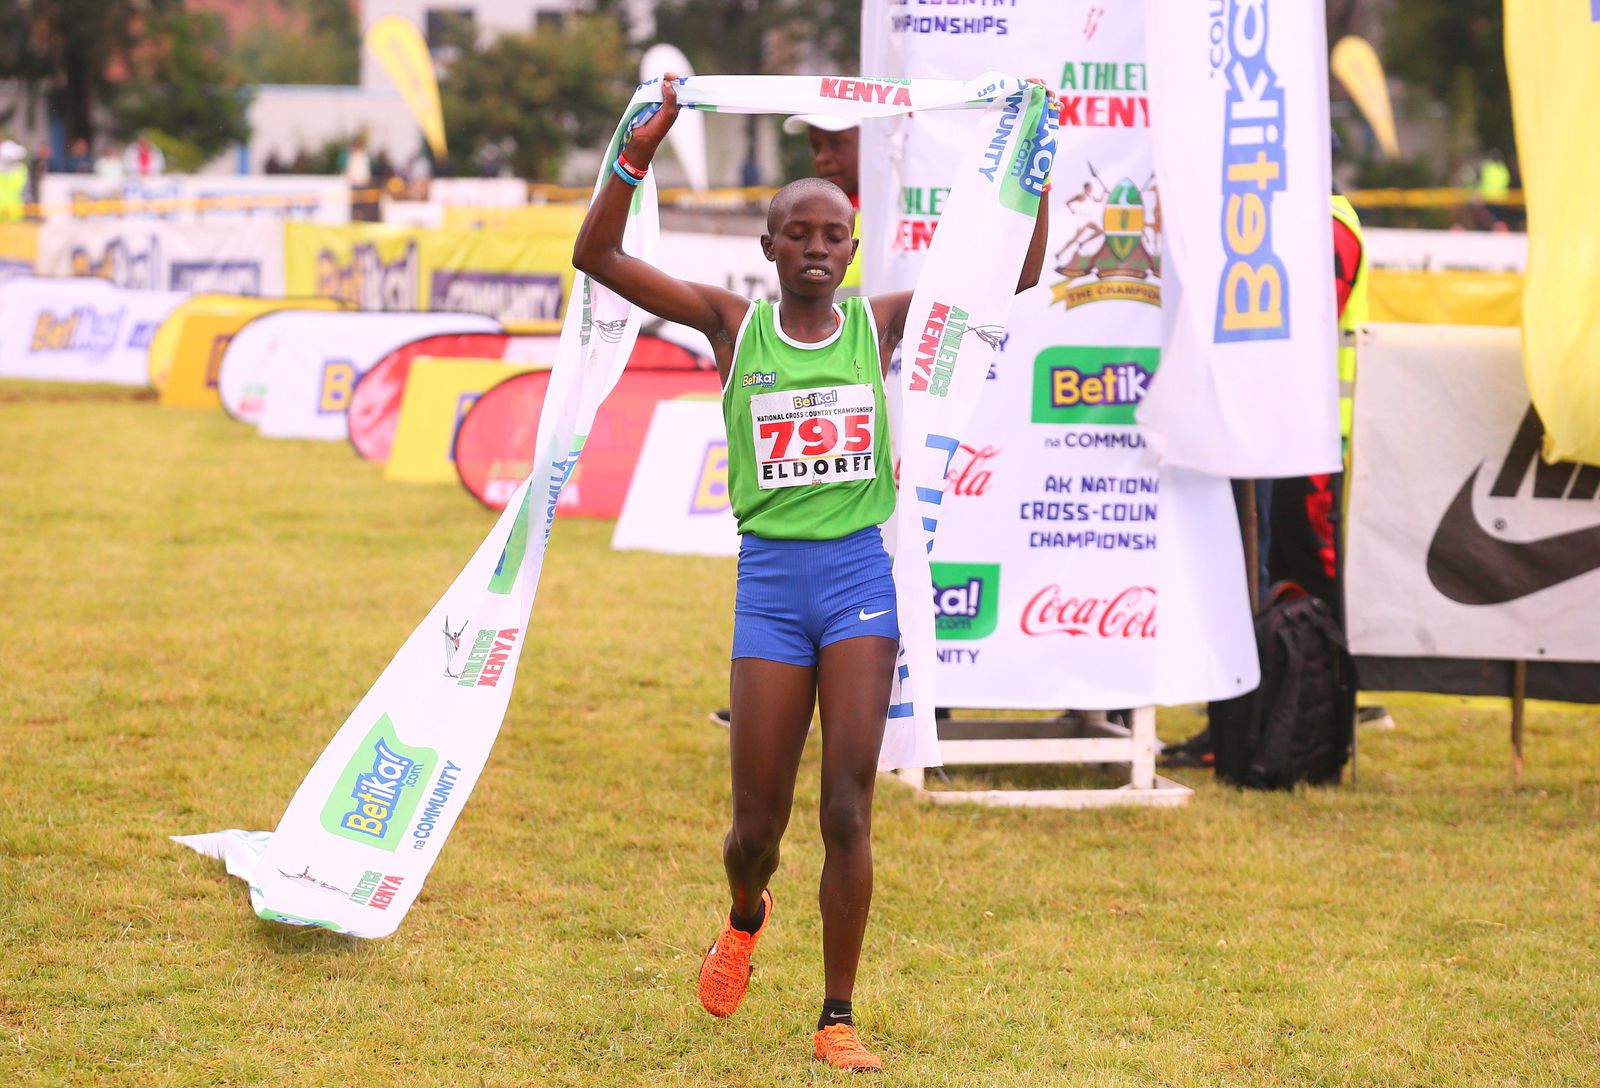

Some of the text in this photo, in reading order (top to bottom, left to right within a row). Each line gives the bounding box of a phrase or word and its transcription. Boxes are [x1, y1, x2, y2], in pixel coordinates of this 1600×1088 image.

[820, 78, 912, 106] KENYA
[1068, 289, 1092, 302] THE
[909, 301, 950, 391] KENYA
[928, 305, 969, 397] ATHLETICS
[742, 372, 776, 387] Betika!
[793, 390, 838, 409] Betika!
[757, 406, 873, 422] NATIONAL CROSS COUNTRY CHAMPIONSHIP
[760, 414, 872, 460] 795
[1045, 432, 1146, 449] na COMMU
[762, 455, 872, 480] ELDORET
[1045, 475, 1072, 493] AK
[457, 629, 497, 687] ATHLETICS
[477, 628, 519, 687] KENYA
[343, 740, 412, 837] Betika!
[405, 763, 425, 788] .com
[413, 759, 462, 850] na COMMUNITY
[368, 875, 405, 911] KENYA
